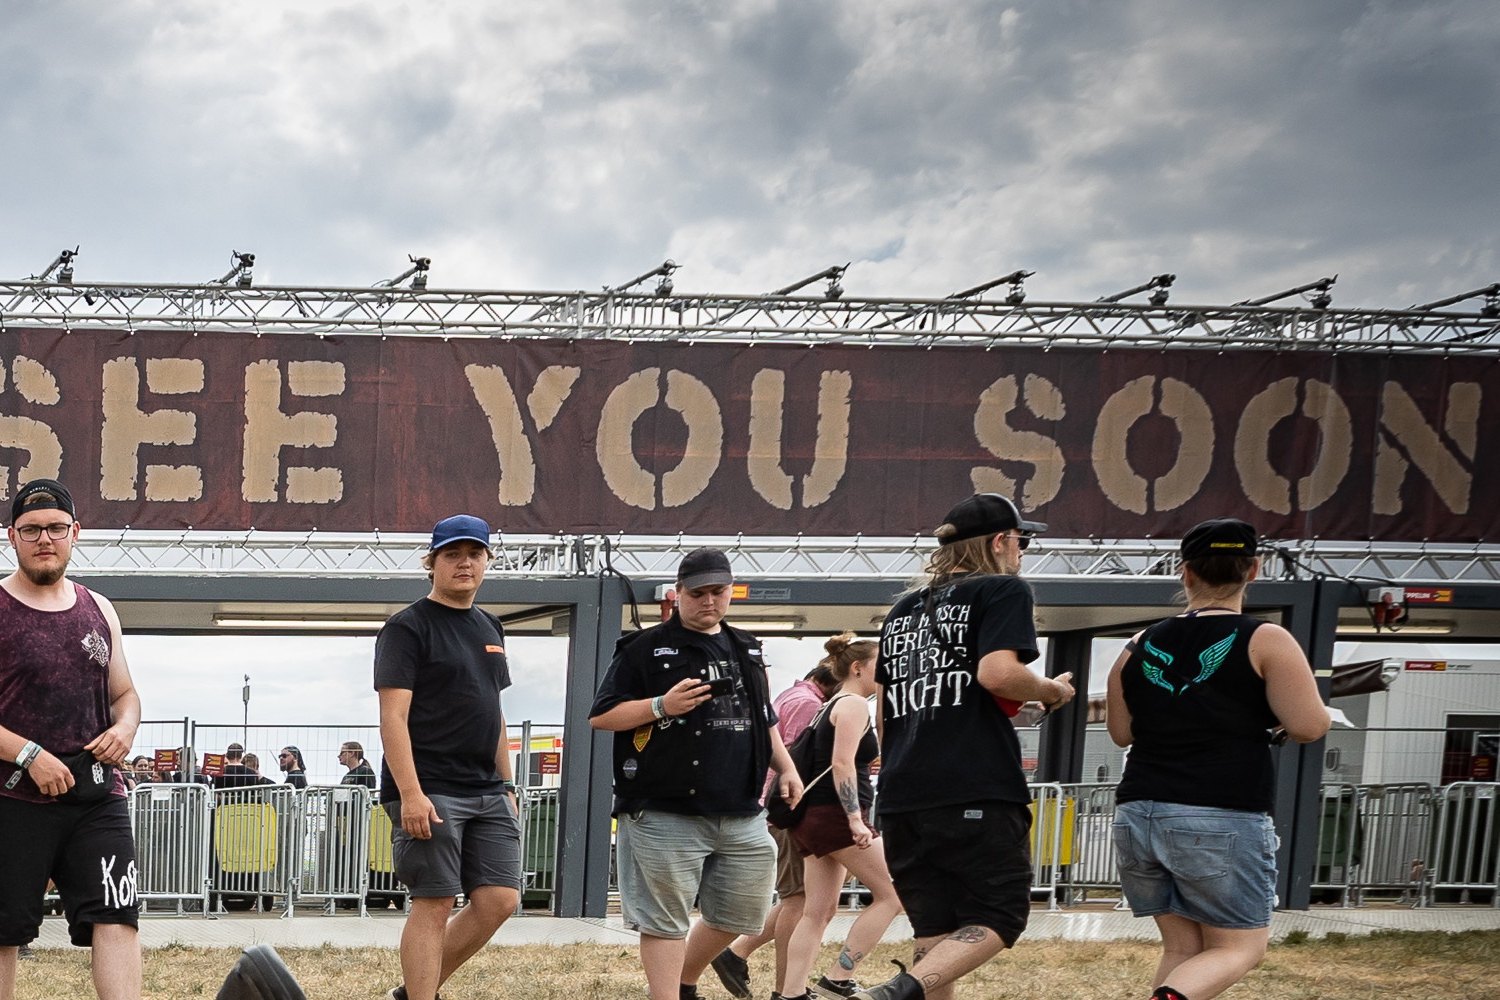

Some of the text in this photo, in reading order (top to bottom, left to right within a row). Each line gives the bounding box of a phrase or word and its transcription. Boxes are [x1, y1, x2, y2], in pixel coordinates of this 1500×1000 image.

[464, 363, 853, 511] YOU
[970, 374, 1482, 516] SOON
[884, 615, 912, 639] DER
[885, 670, 972, 719] NICHT
